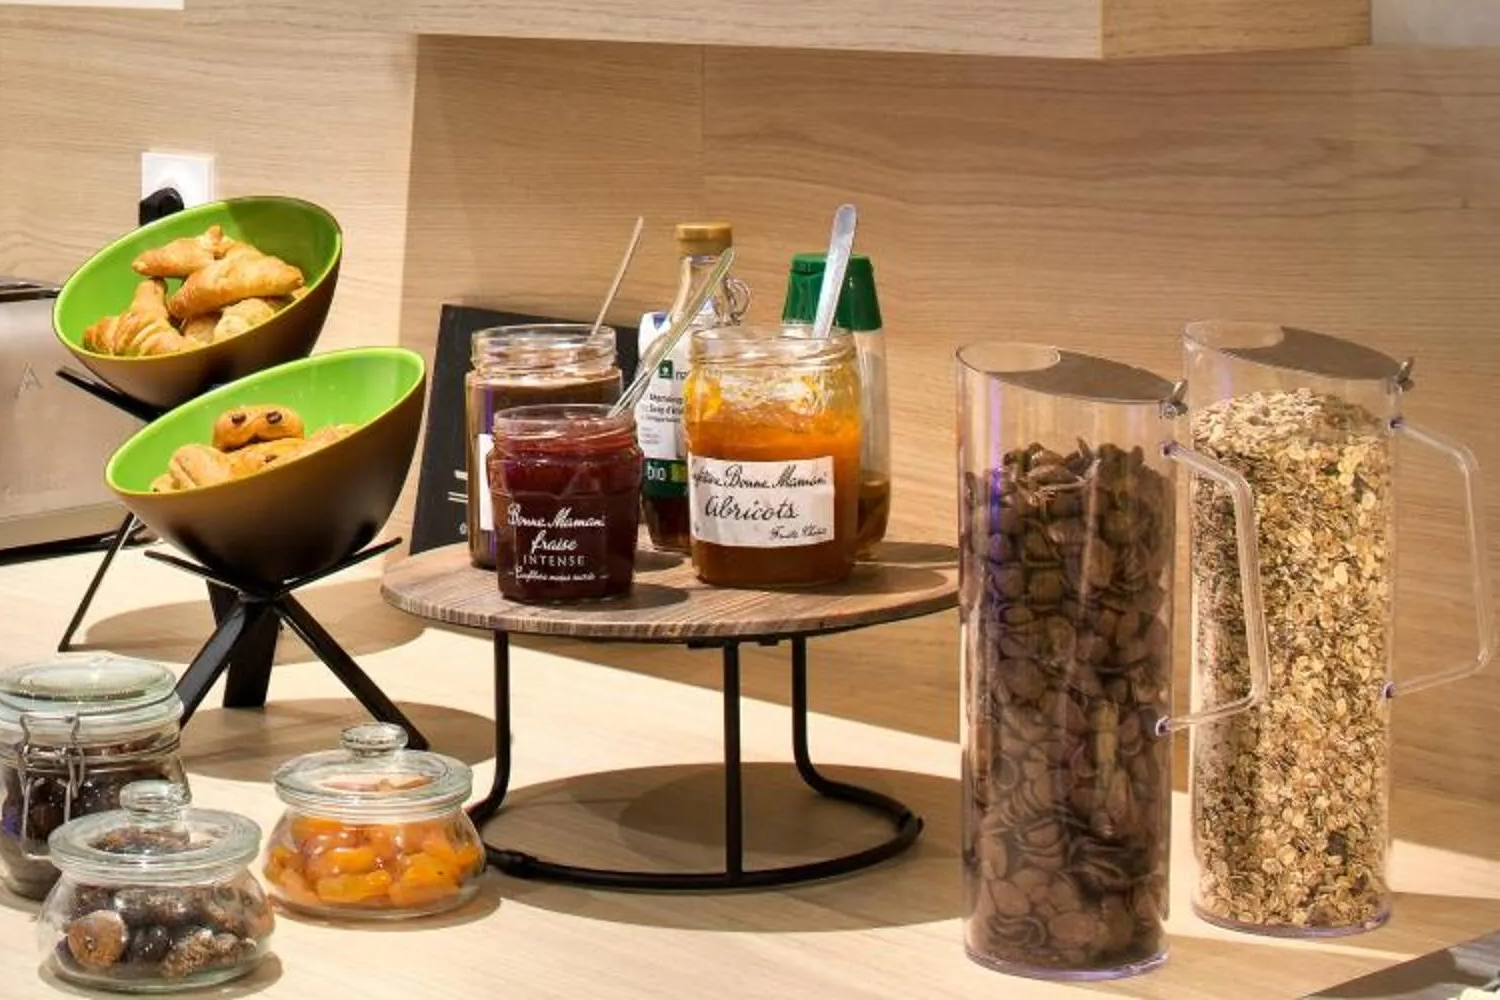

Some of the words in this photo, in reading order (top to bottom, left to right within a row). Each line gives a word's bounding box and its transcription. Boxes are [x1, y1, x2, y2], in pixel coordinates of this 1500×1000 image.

[647, 461, 667, 481] bio
[723, 464, 770, 489] Bonne
[771, 464, 828, 489] Maman
[507, 502, 547, 527] Bonne
[547, 506, 606, 528] Maman
[531, 529, 580, 555] fraise
[523, 554, 585, 567] INTENSE
